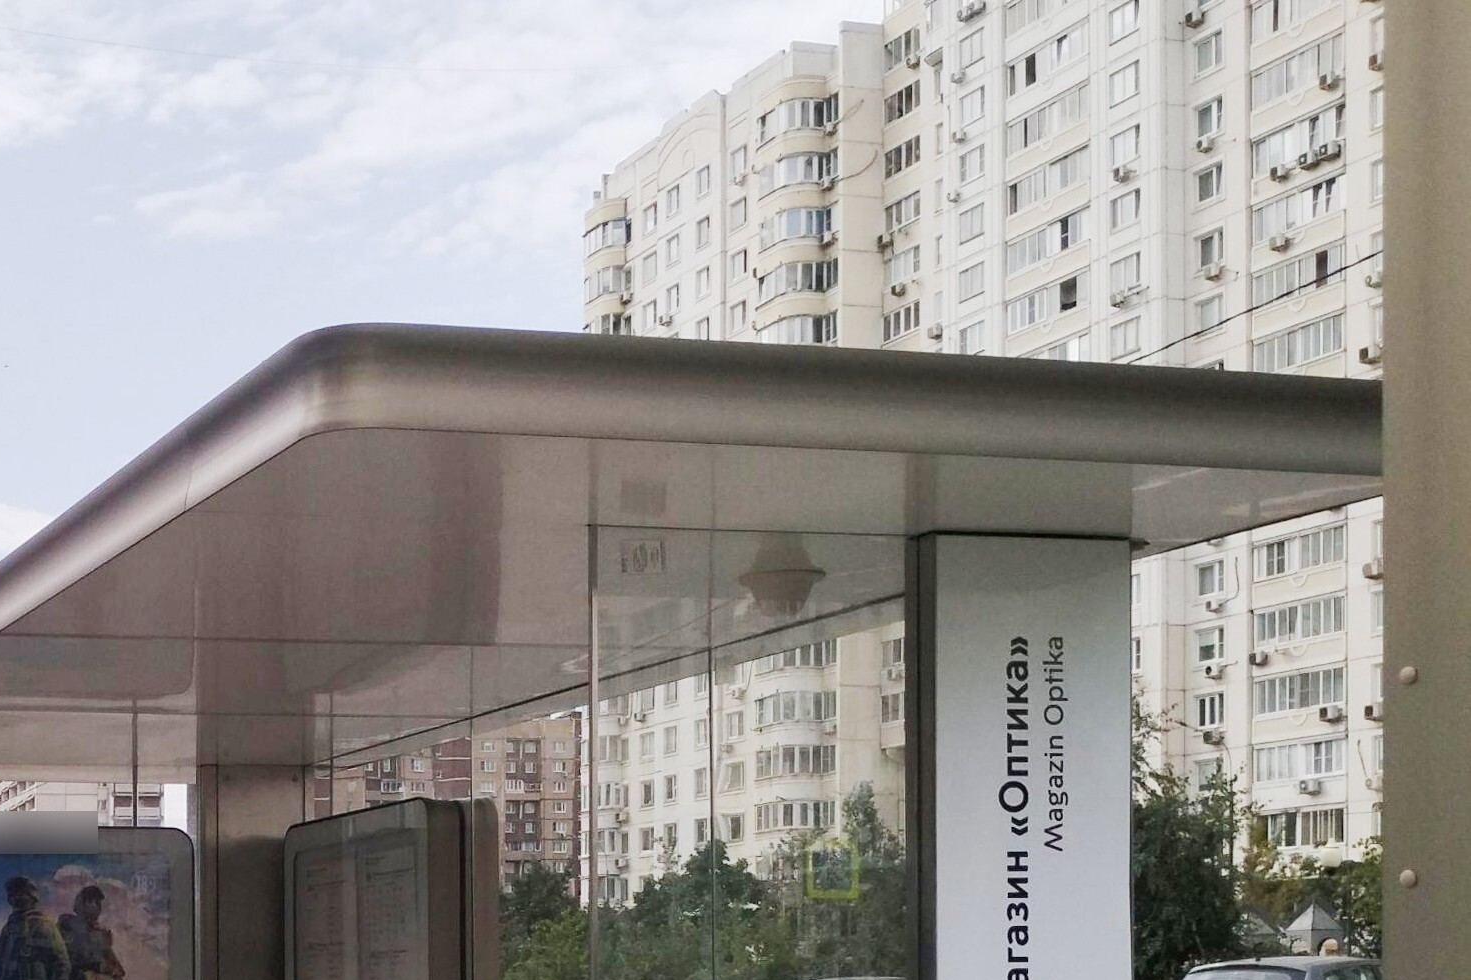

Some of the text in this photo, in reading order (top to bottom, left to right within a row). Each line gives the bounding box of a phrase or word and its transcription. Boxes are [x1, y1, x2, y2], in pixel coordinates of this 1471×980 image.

[998, 635, 1029, 838] «Оптика»
[1043, 635, 1068, 852] Magazin Optika
